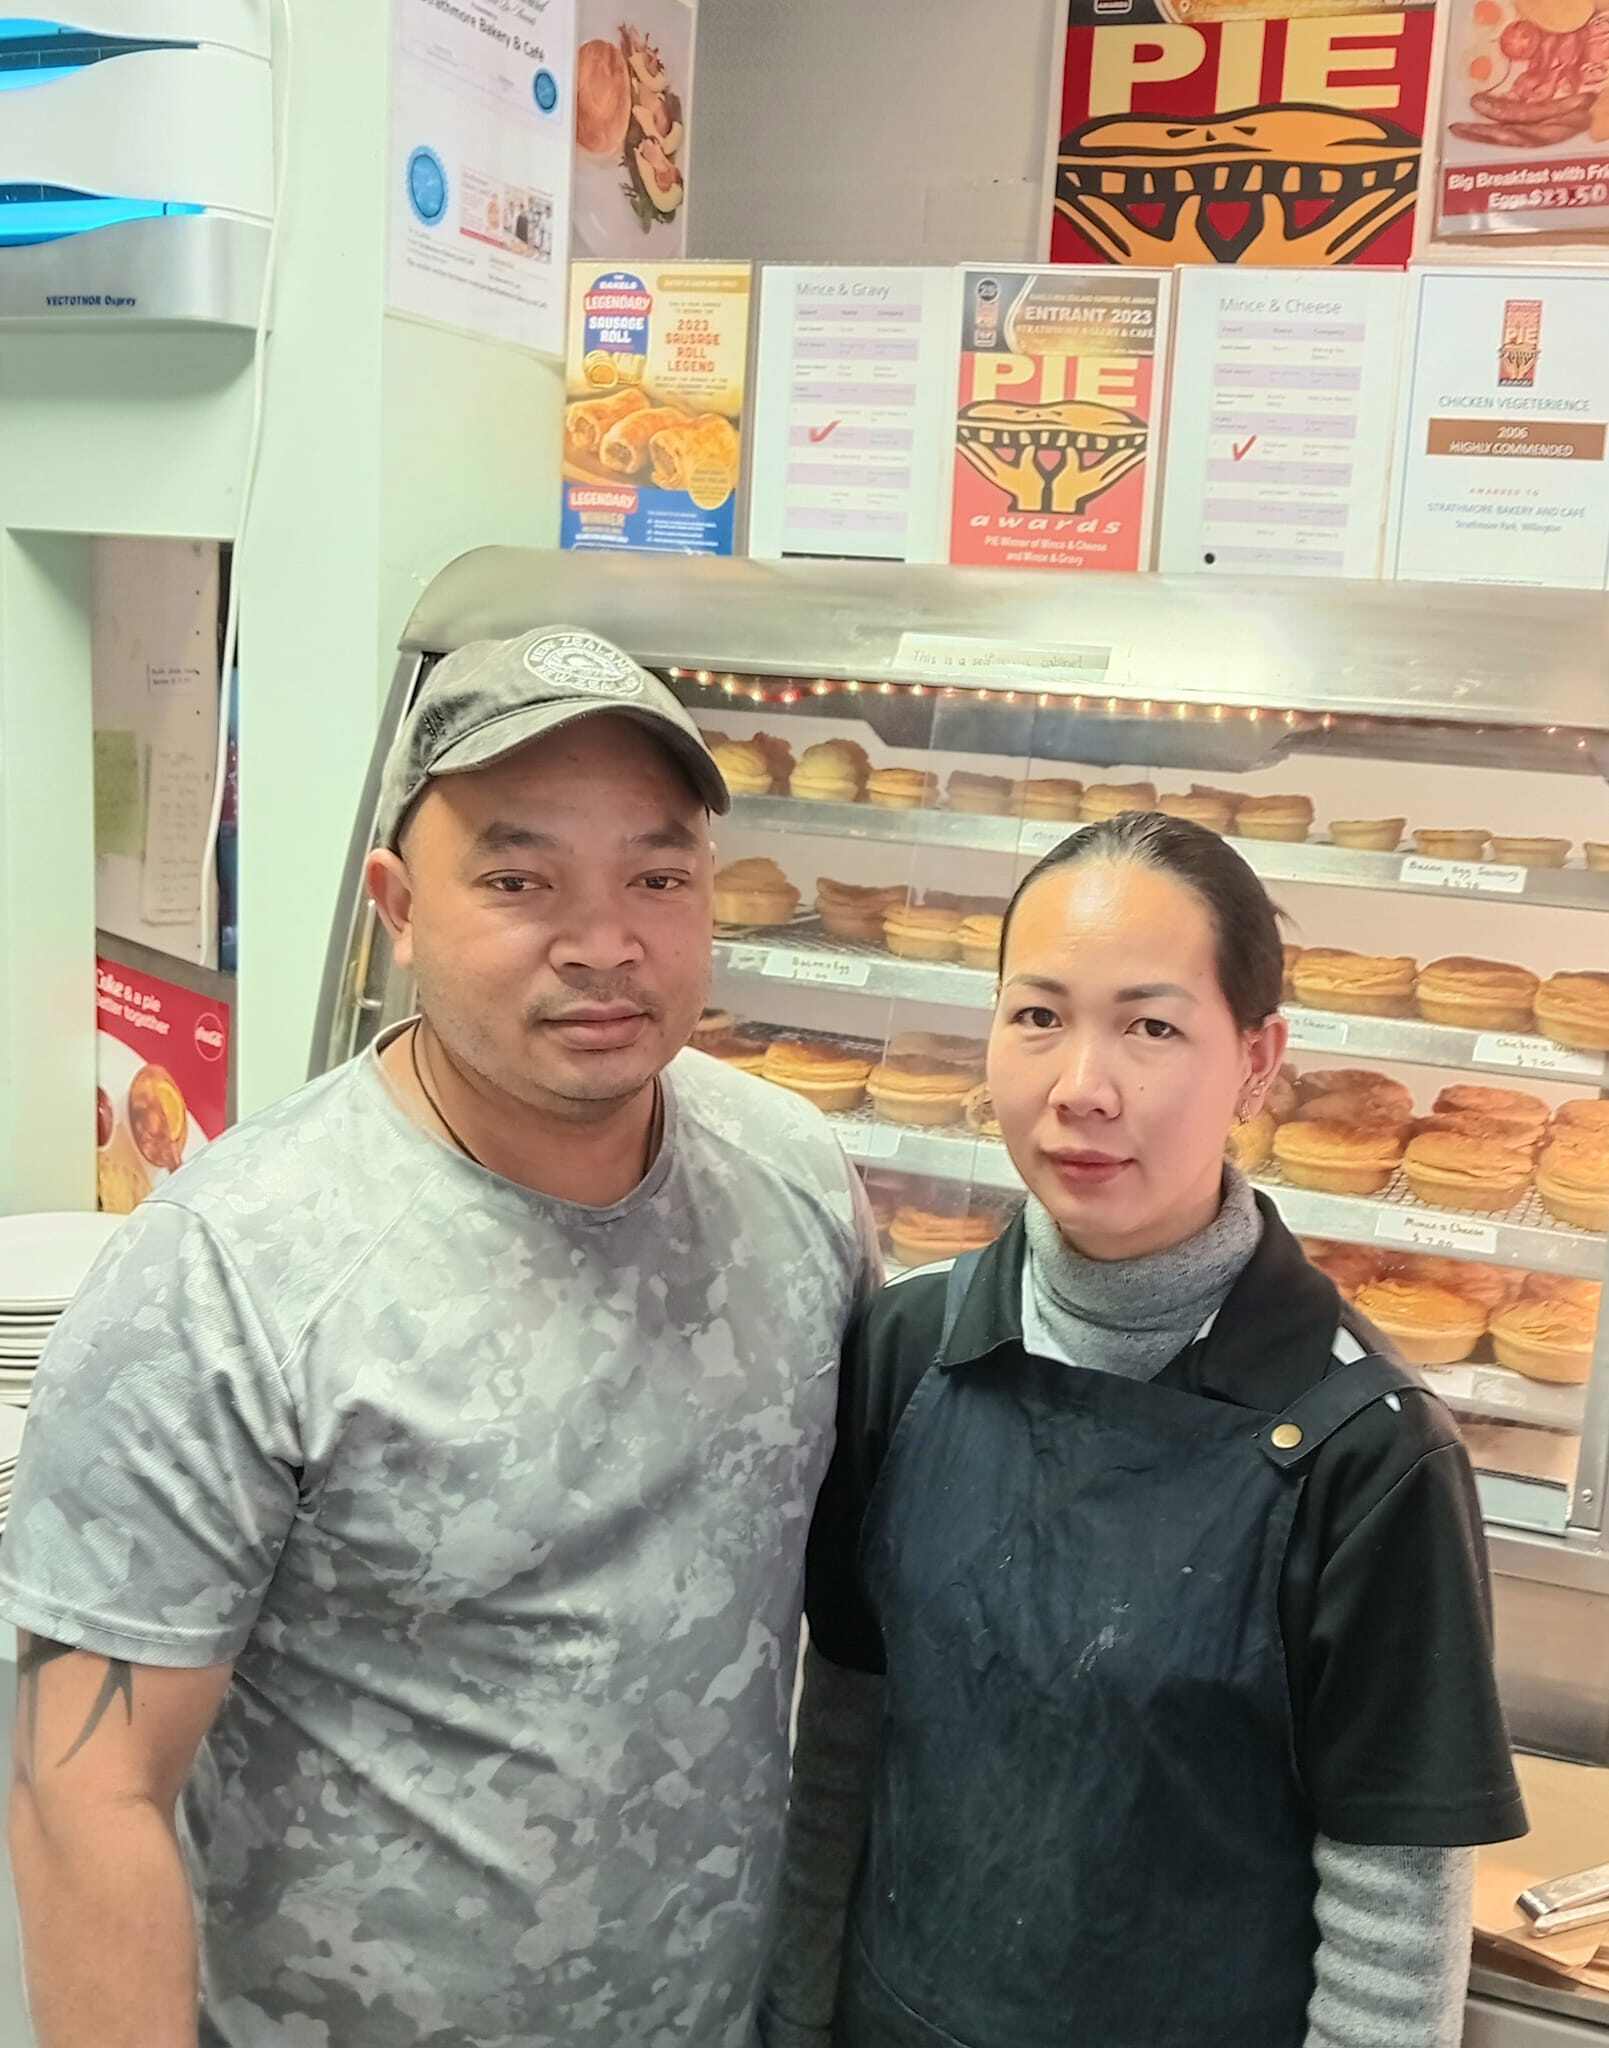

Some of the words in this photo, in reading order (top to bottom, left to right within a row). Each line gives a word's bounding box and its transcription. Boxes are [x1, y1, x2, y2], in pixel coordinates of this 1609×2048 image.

[1089, 12, 1405, 117] PIE
[1448, 174, 1474, 192] Big
[1476, 168, 1549, 188] Breakfast
[1551, 166, 1585, 182] with
[797, 283, 836, 297] Mince
[838, 283, 848, 296] &
[852, 283, 890, 300] Gravy
[586, 295, 650, 311] LEGENDARY
[1218, 298, 1264, 312] Mince
[1269, 298, 1280, 312] &
[1285, 298, 1343, 315] Cheese
[589, 316, 645, 330] SAUSAGE
[1025, 306, 1108, 323] ENTRANT
[1111, 309, 1153, 325] 2023
[677, 319, 709, 331] 2023
[600, 331, 632, 343] ROLL
[665, 333, 721, 346] SAUSAGE
[677, 347, 707, 359] ROLL
[668, 361, 715, 373] LEGEND
[972, 352, 1139, 408] PIE
[1438, 394, 1494, 409] CHICKEN
[1499, 396, 1592, 412] VEGETERIENCE
[1497, 426, 1529, 439] 2006
[1449, 440, 1491, 454] HIGHLY
[1492, 442, 1575, 457] COMMENDED
[570, 491, 636, 508] LEGENDARY
[1427, 502, 1493, 515] STRATHMORE
[1497, 504, 1534, 516] BAKERY
[1536, 505, 1559, 517] AND
[970, 513, 1122, 535] awards
[913, 650, 937, 665] This
[958, 657, 967, 667] a
[1408, 860, 1443, 872] Bacon
[1451, 866, 1472, 881] Egg
[1403, 1216, 1437, 1230] Mince
[1450, 1221, 1485, 1236] Cheese
